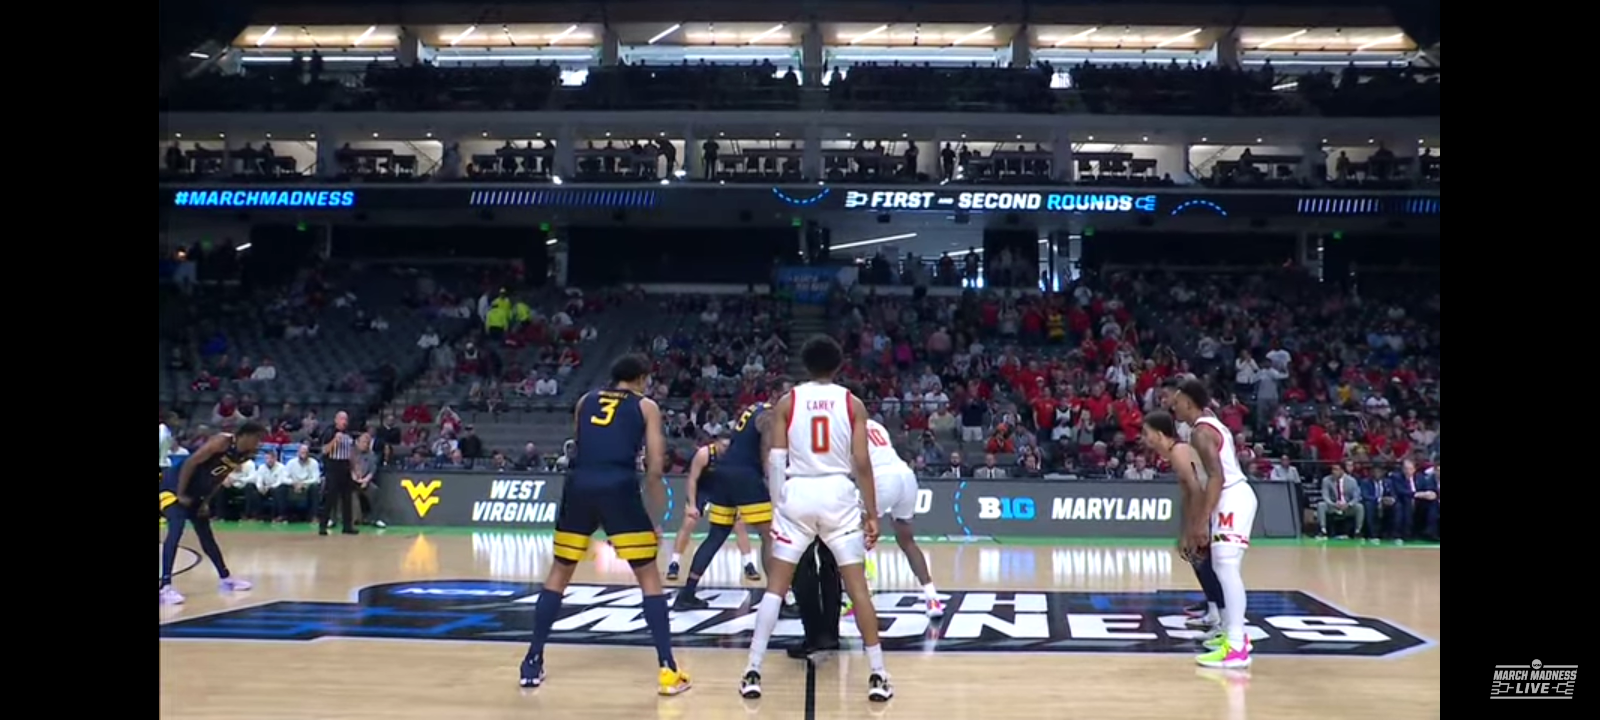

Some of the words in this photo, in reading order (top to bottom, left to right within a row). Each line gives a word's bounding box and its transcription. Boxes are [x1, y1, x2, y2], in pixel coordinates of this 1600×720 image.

[174, 191, 355, 206] #MARCHMADNESS
[871, 191, 934, 208] FIRST
[958, 193, 1041, 210] SECOND
[1047, 195, 1133, 211] ROUNDS
[590, 396, 619, 426] 3
[806, 400, 835, 411] CAREY
[735, 410, 752, 432] 5
[811, 416, 830, 454] 0
[490, 480, 546, 500] WEST
[472, 501, 557, 523] VIRGINIA
[1052, 498, 1172, 521] MARYLAND
[1218, 512, 1234, 528] M
